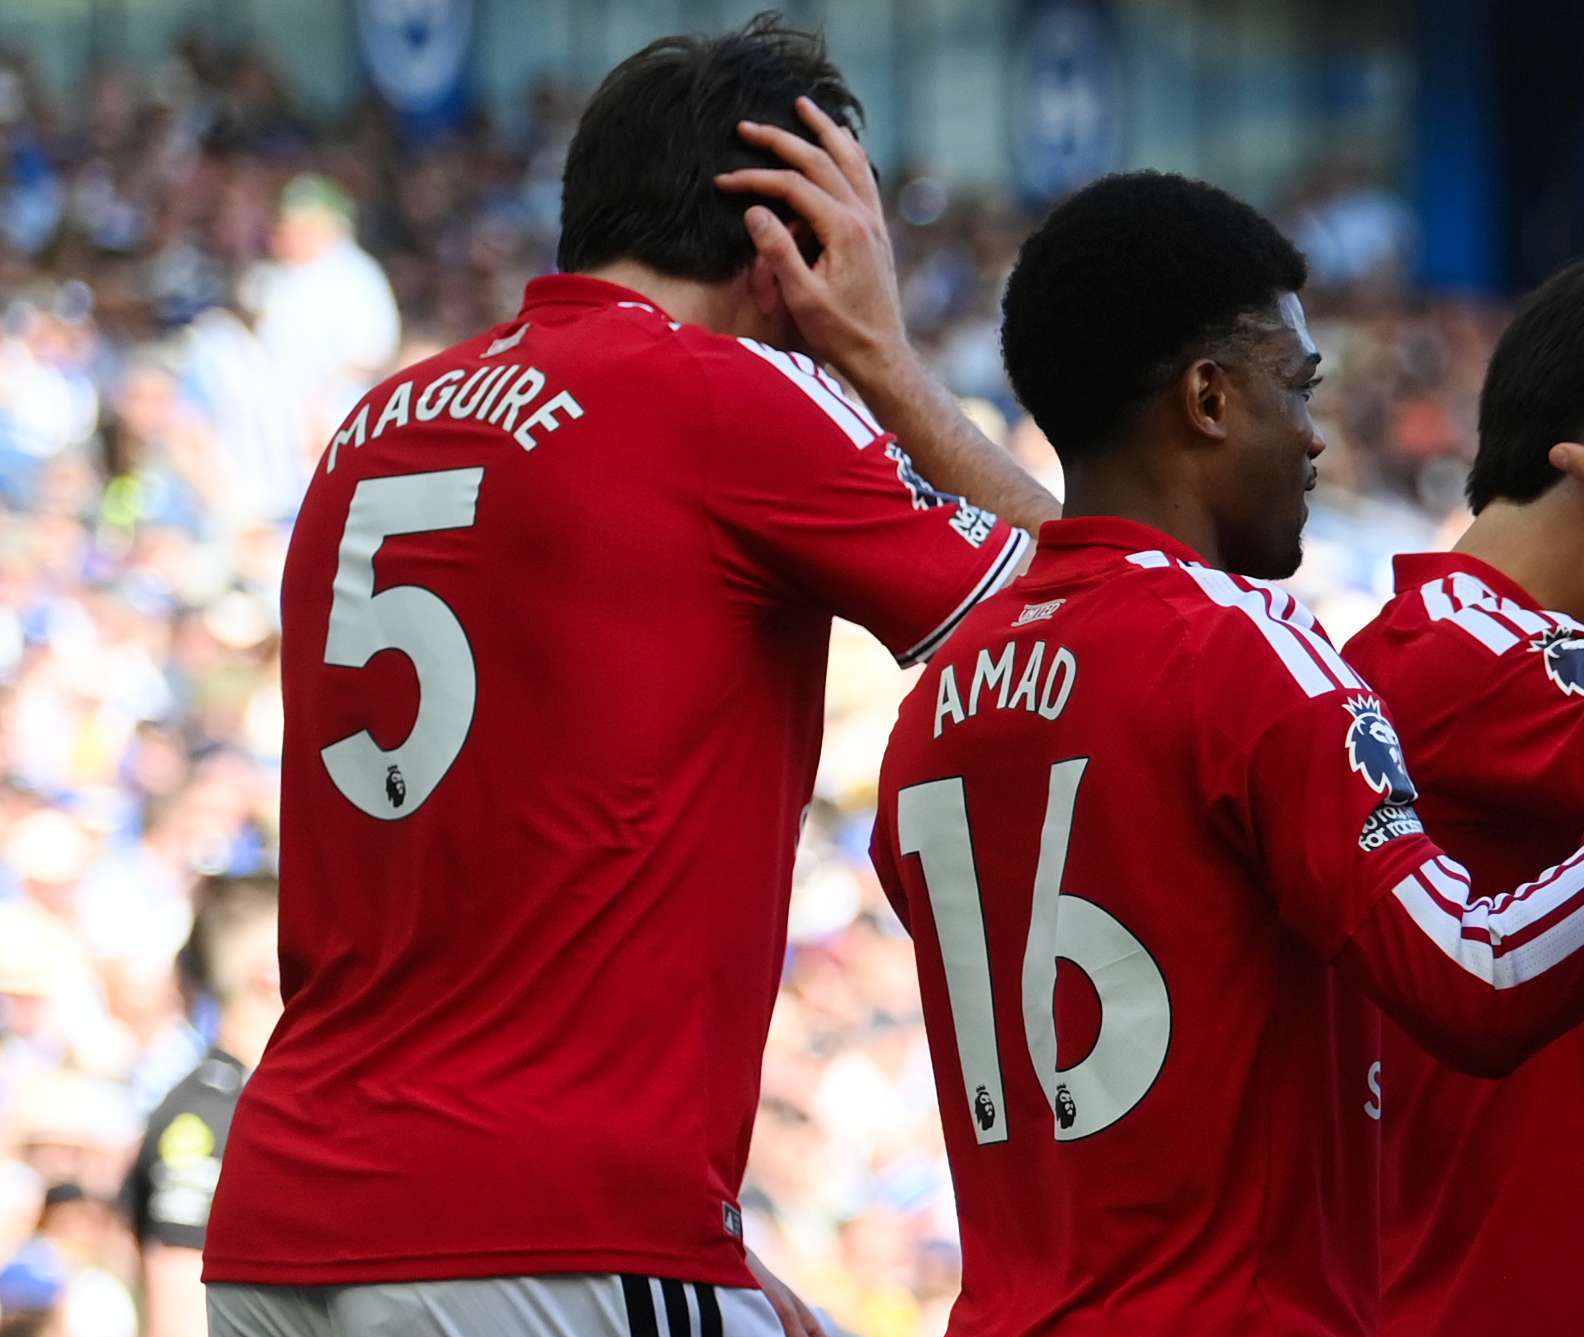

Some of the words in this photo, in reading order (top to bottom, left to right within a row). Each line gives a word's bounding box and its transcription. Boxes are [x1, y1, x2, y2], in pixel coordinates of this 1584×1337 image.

[326, 364, 584, 474] MAGUIRE
[320, 466, 485, 820] 5
[933, 640, 1076, 739] AMAD
[898, 757, 1172, 1144] 16
